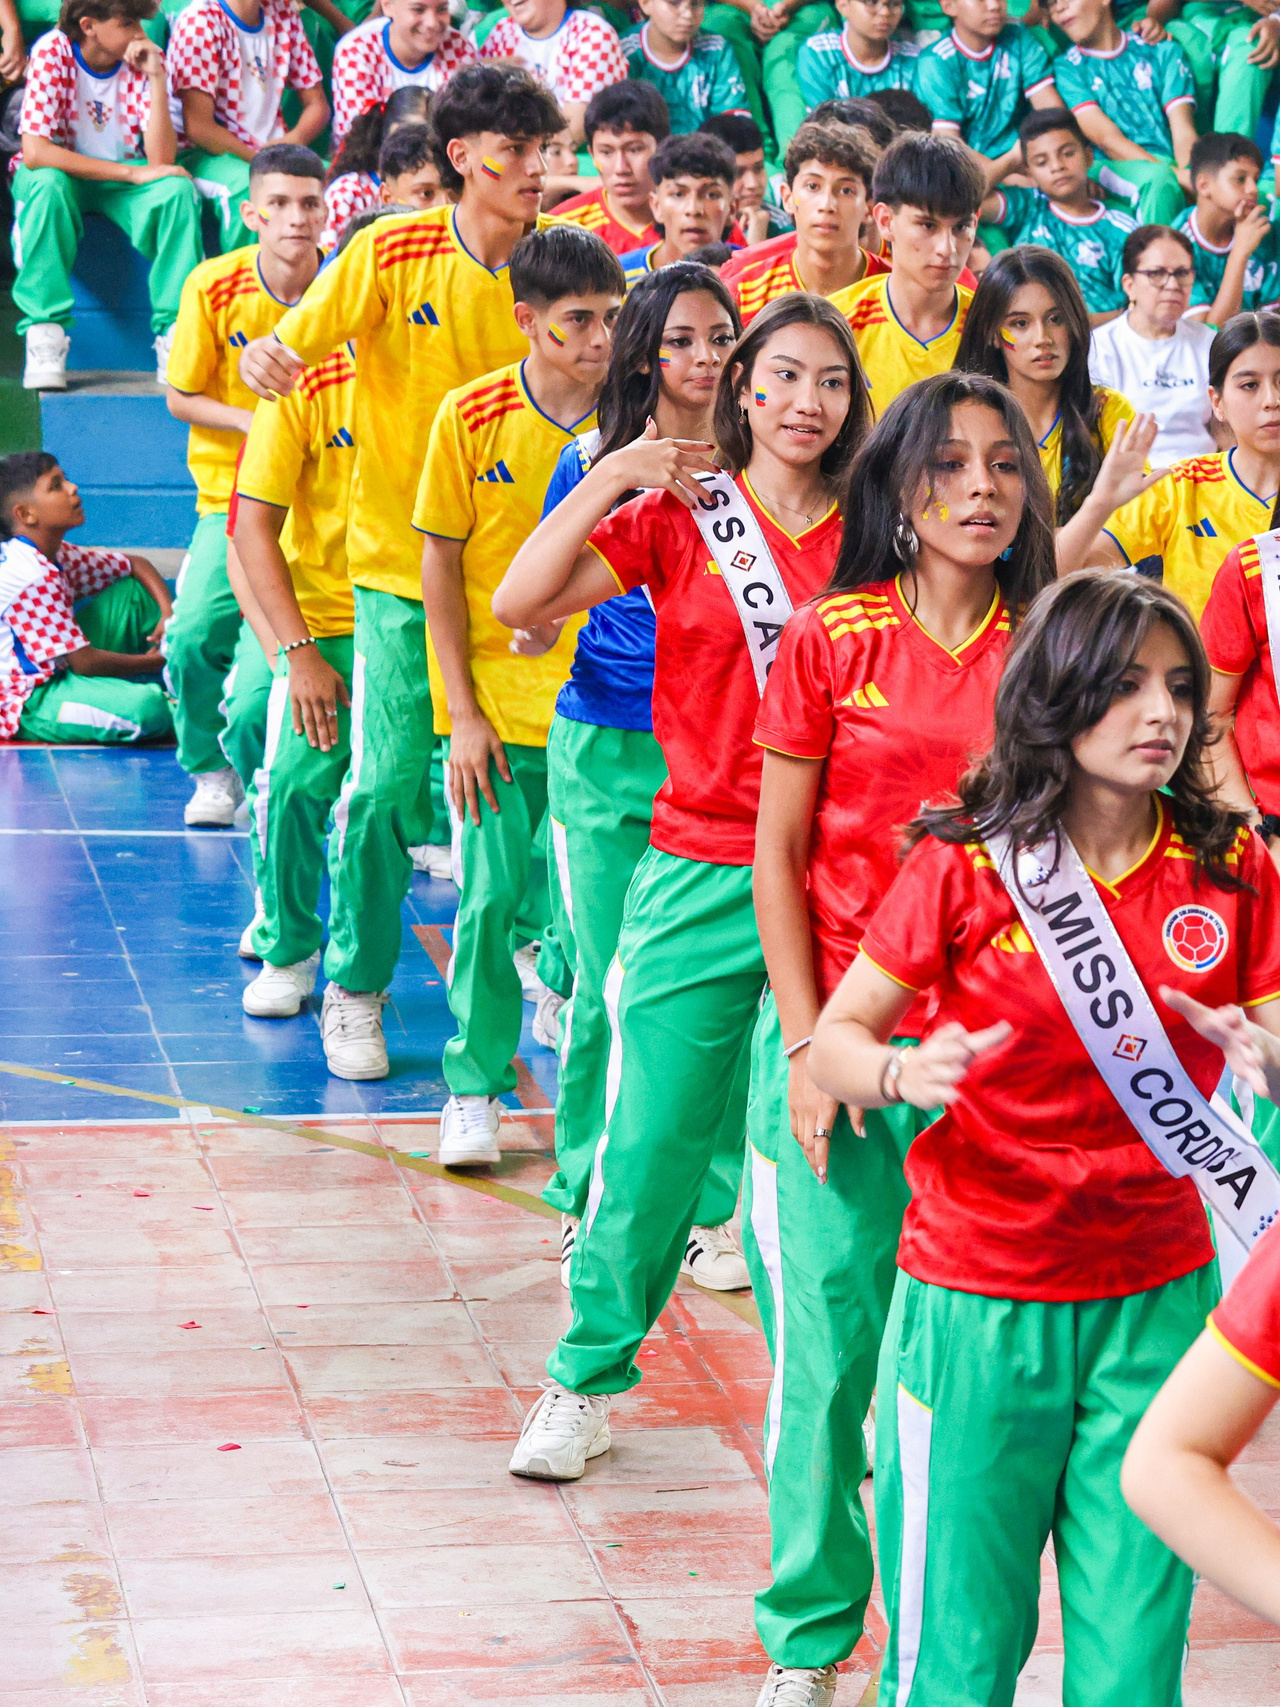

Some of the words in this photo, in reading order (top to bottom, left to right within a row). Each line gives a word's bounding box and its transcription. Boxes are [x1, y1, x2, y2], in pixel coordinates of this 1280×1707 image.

[697, 475, 746, 543] ISS
[742, 581, 785, 677] CA
[1041, 892, 1134, 1029] MISS
